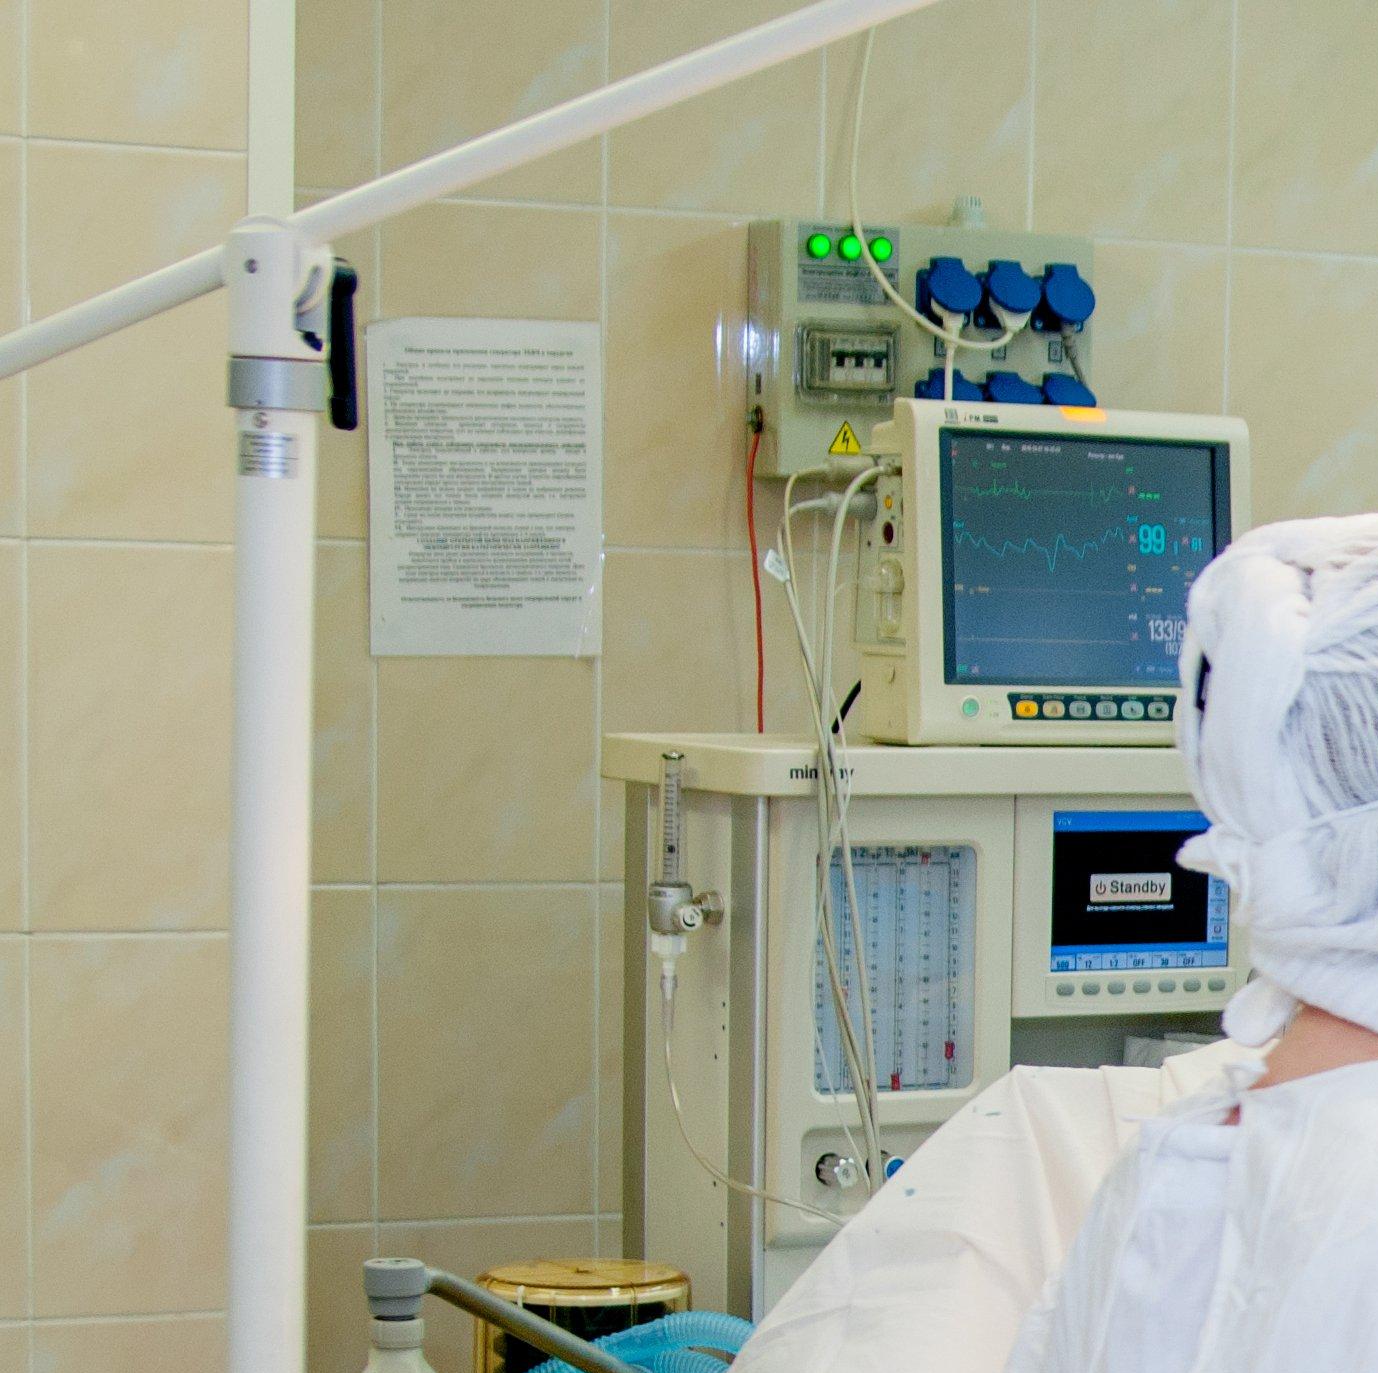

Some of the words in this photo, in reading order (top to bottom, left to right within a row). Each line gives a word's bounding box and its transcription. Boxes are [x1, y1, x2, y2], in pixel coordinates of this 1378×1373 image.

[1139, 523, 1165, 556] 99
[790, 764, 854, 784] minay
[1110, 880, 1166, 896] Standby
